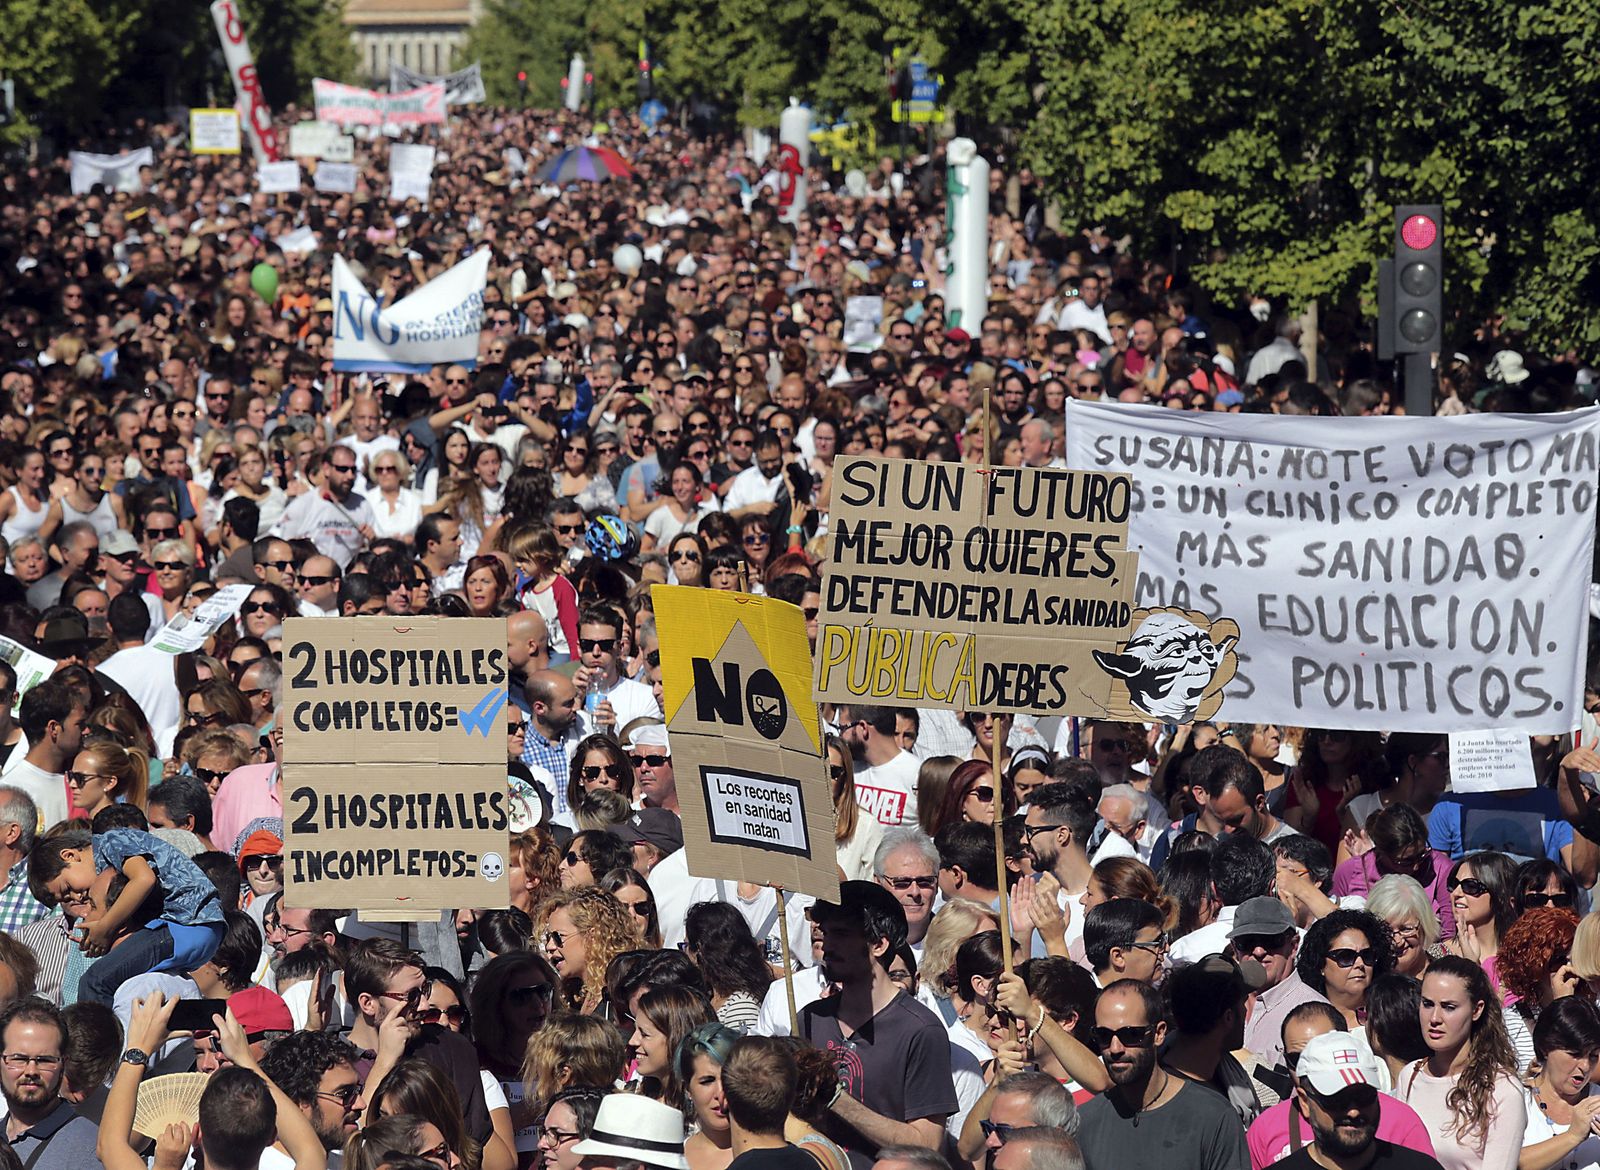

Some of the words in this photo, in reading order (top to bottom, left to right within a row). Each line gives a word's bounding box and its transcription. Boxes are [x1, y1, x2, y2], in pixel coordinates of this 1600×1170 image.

[334, 290, 400, 346] NO
[1094, 435, 1270, 480] SUSANA:
[1408, 438, 1533, 478] VOTO
[840, 460, 889, 507] SI
[901, 463, 965, 512] UN
[987, 468, 1131, 523] FUTURO
[1177, 484, 1228, 519] UN
[1417, 478, 1592, 519] COMPLETO
[833, 518, 953, 571] MEJOR
[963, 525, 1121, 587] QUIERES,
[1176, 521, 1271, 568] MÁS
[1043, 595, 1131, 628] SANIDAD
[1257, 592, 1558, 658] EDUCACION.
[289, 641, 318, 689] 2
[324, 648, 506, 687] HOSPITALES
[818, 617, 978, 706] PÚBLICA
[979, 662, 1069, 710] DEBES
[1291, 655, 1564, 718] POLITICOS.
[691, 657, 788, 740] NO
[289, 786, 319, 834] 2
[324, 792, 508, 831] HOSPITALES
[716, 778, 742, 796] Los
[744, 785, 793, 805] recortes
[725, 801, 742, 814] en
[744, 803, 792, 823] sanidad
[856, 785, 902, 824] RVEL
[743, 821, 781, 840] matan
